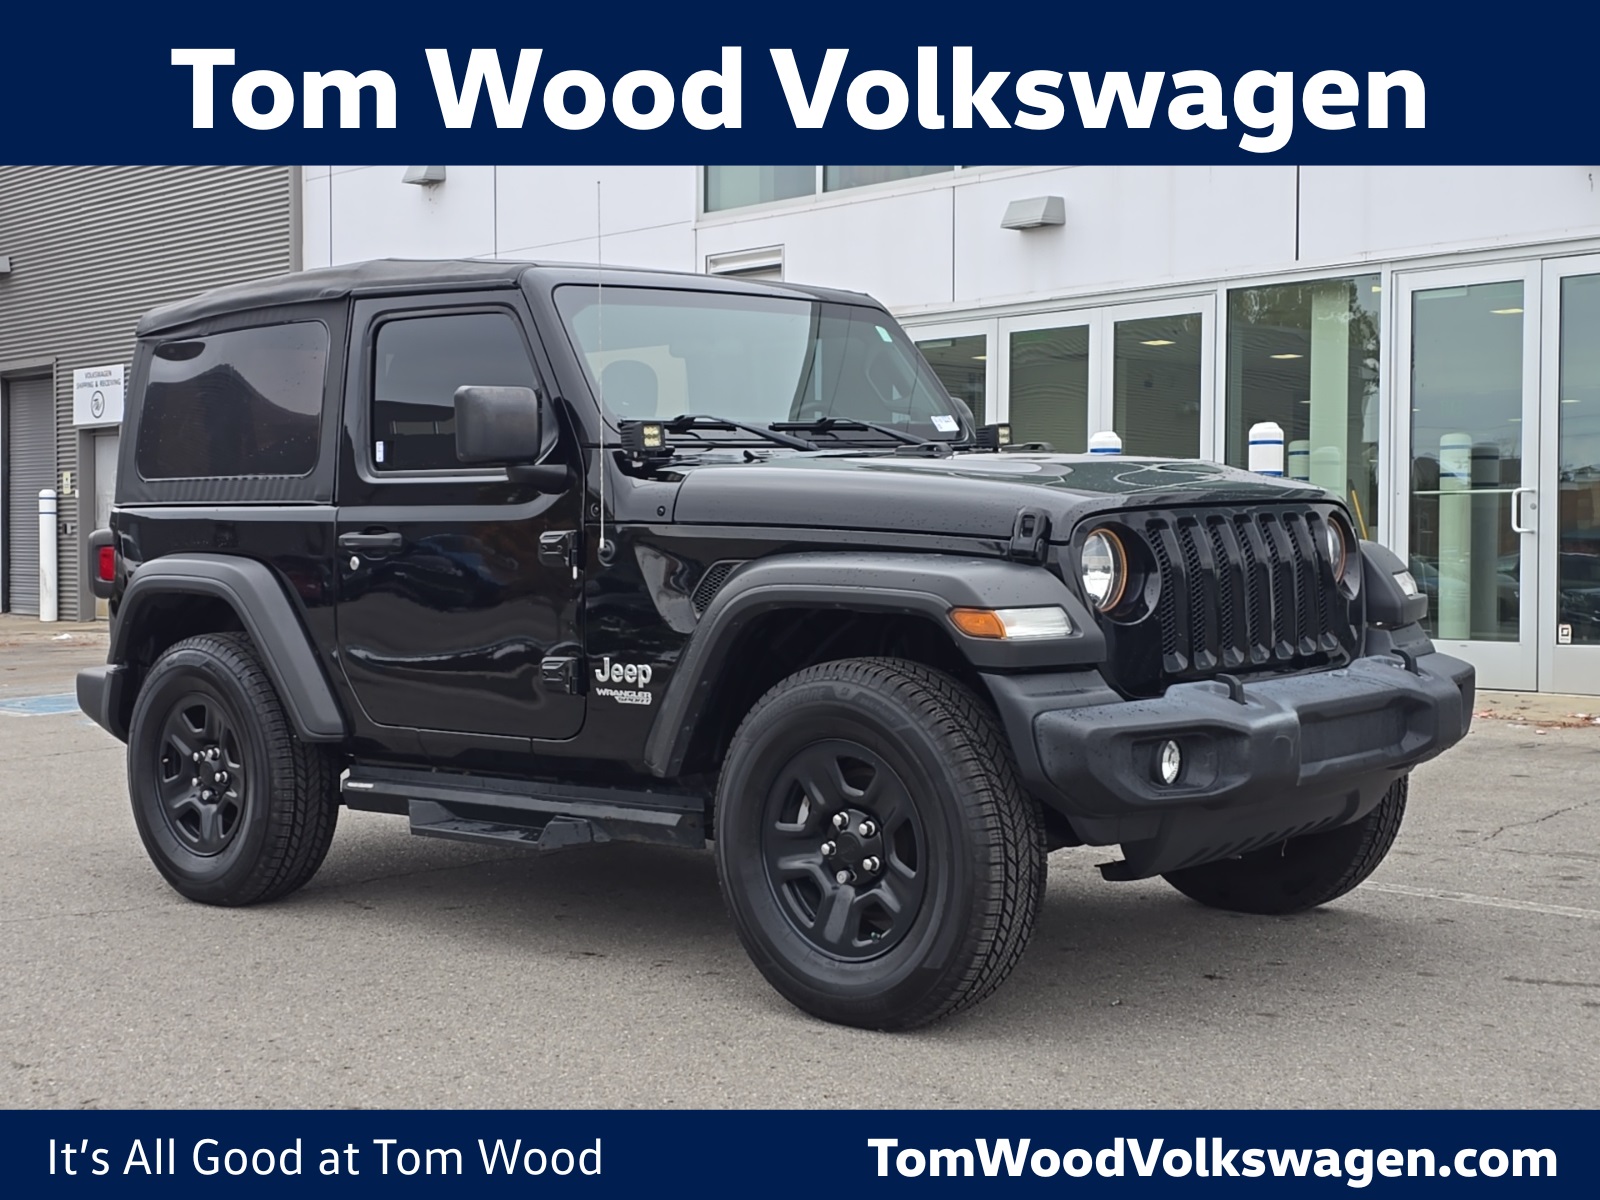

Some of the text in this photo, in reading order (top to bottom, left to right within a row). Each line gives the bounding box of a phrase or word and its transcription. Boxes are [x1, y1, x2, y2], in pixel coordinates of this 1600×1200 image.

[84, 370, 112, 379] VOLKSWAGEN
[595, 657, 652, 688] Jeep
[596, 688, 652, 698] WRANGLER
